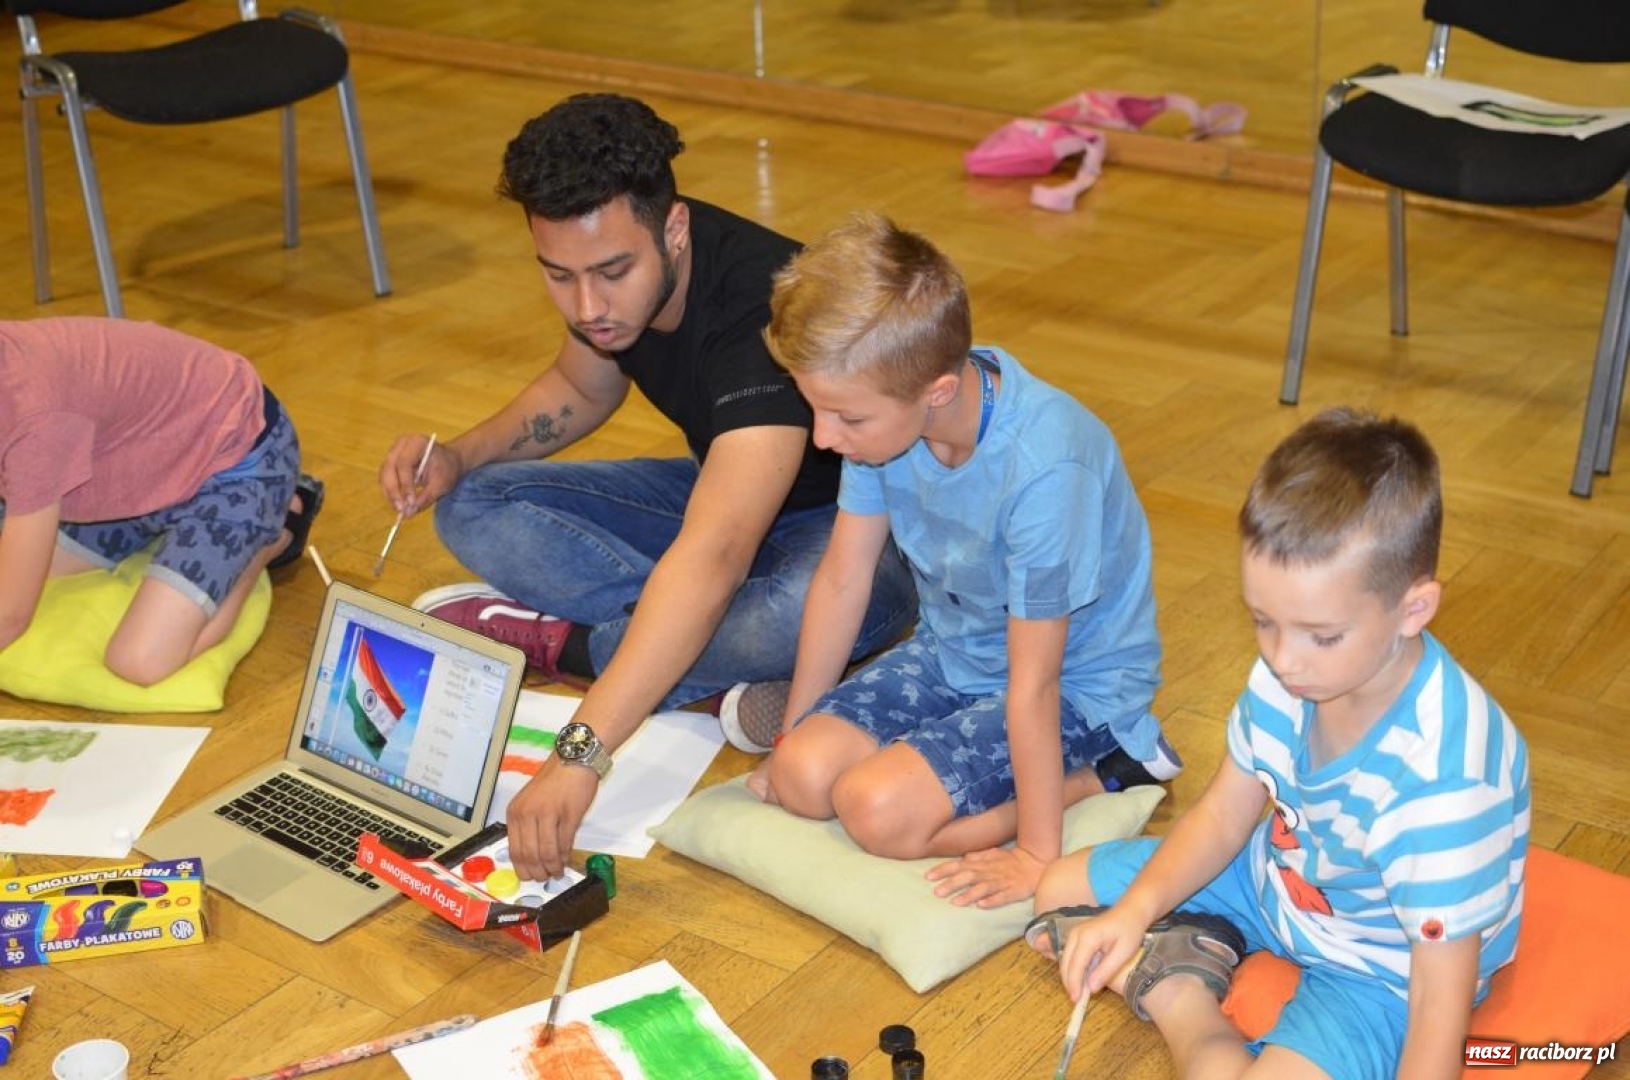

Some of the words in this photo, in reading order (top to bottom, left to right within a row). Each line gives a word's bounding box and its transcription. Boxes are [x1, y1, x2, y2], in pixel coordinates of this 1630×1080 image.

[28, 871, 117, 893] PLAKATOWE
[123, 868, 171, 878] FARBY
[380, 857, 432, 895] plakatowe
[432, 892, 463, 918] Farby
[40, 938, 80, 952] FARBY
[86, 928, 161, 946] PLAKATOWE
